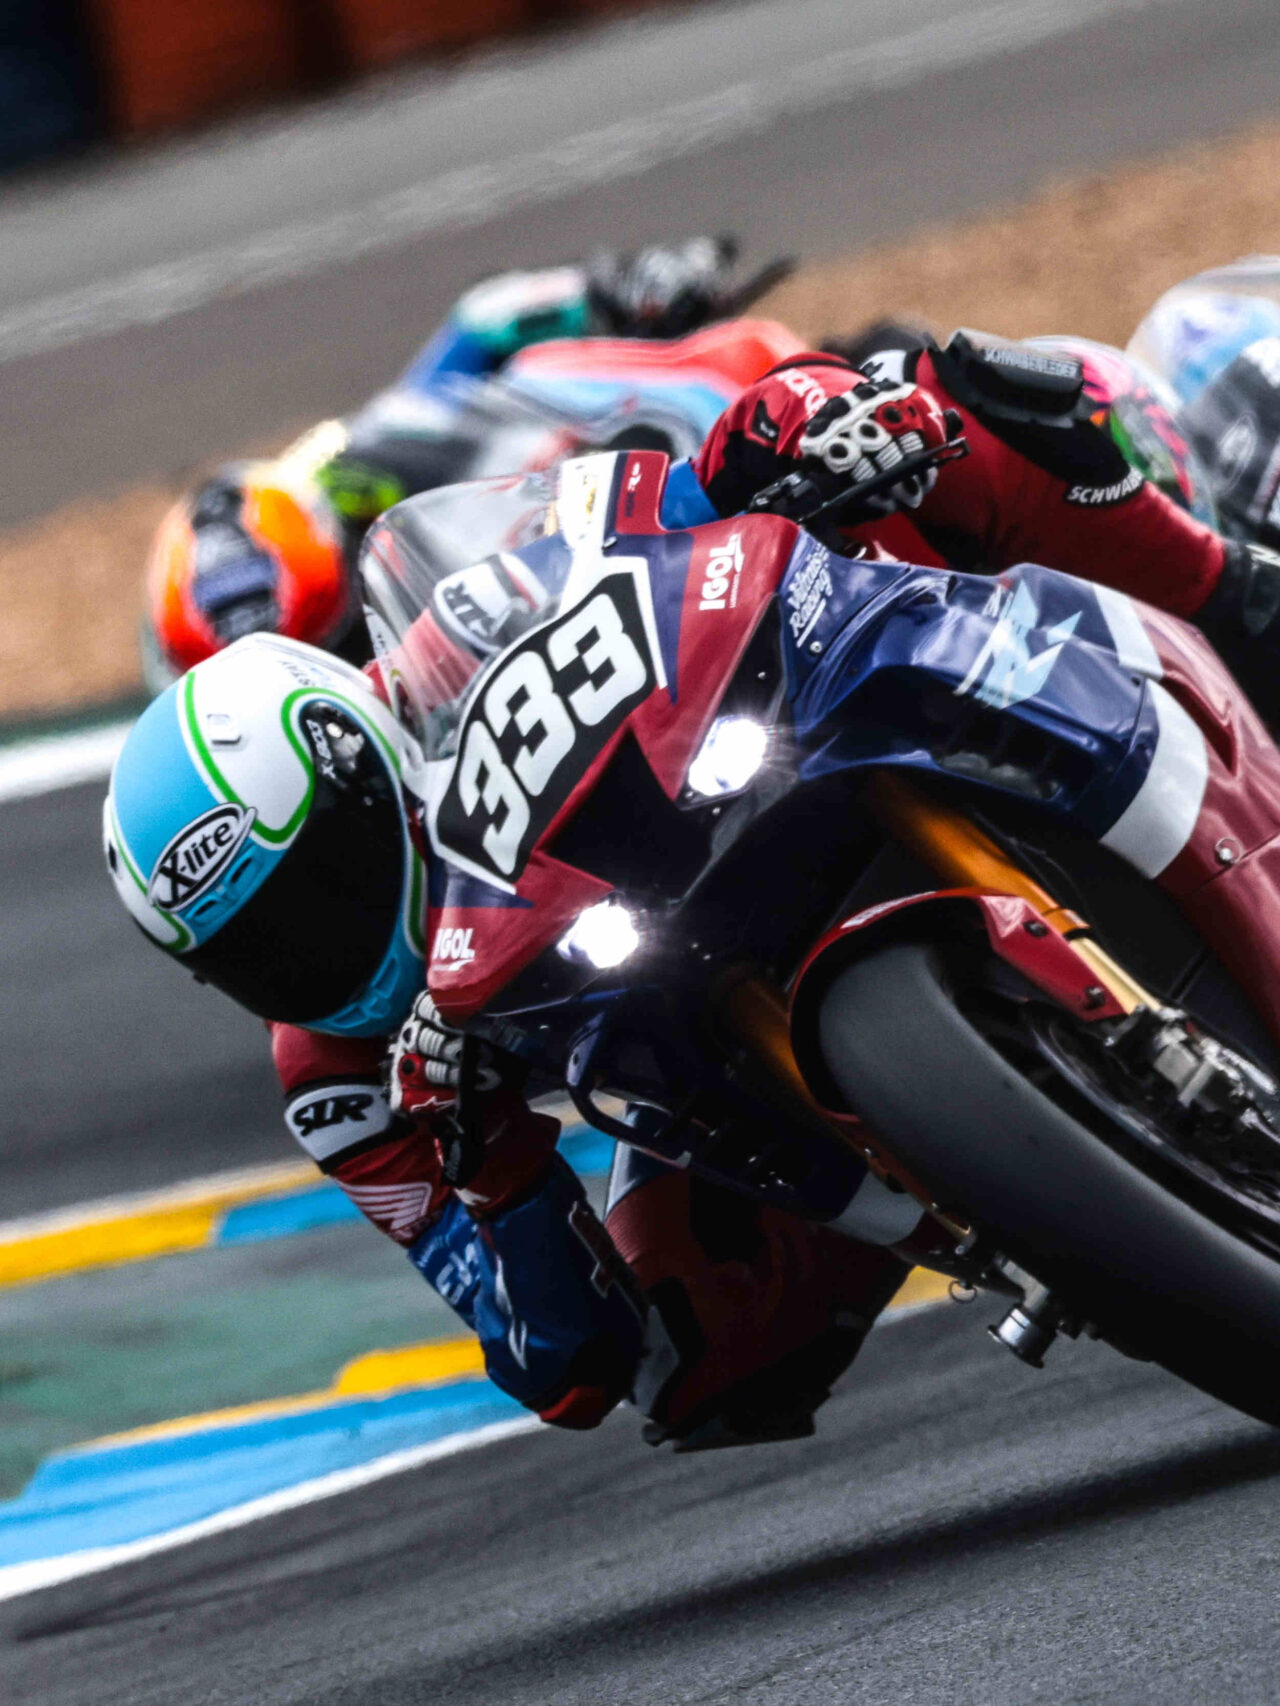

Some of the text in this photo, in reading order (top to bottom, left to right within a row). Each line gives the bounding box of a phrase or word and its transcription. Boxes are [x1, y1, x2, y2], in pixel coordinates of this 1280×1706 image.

[698, 533, 743, 612] IGOL
[458, 592, 647, 876] 333
[158, 822, 235, 904] X-lite
[432, 927, 476, 961] IGOL
